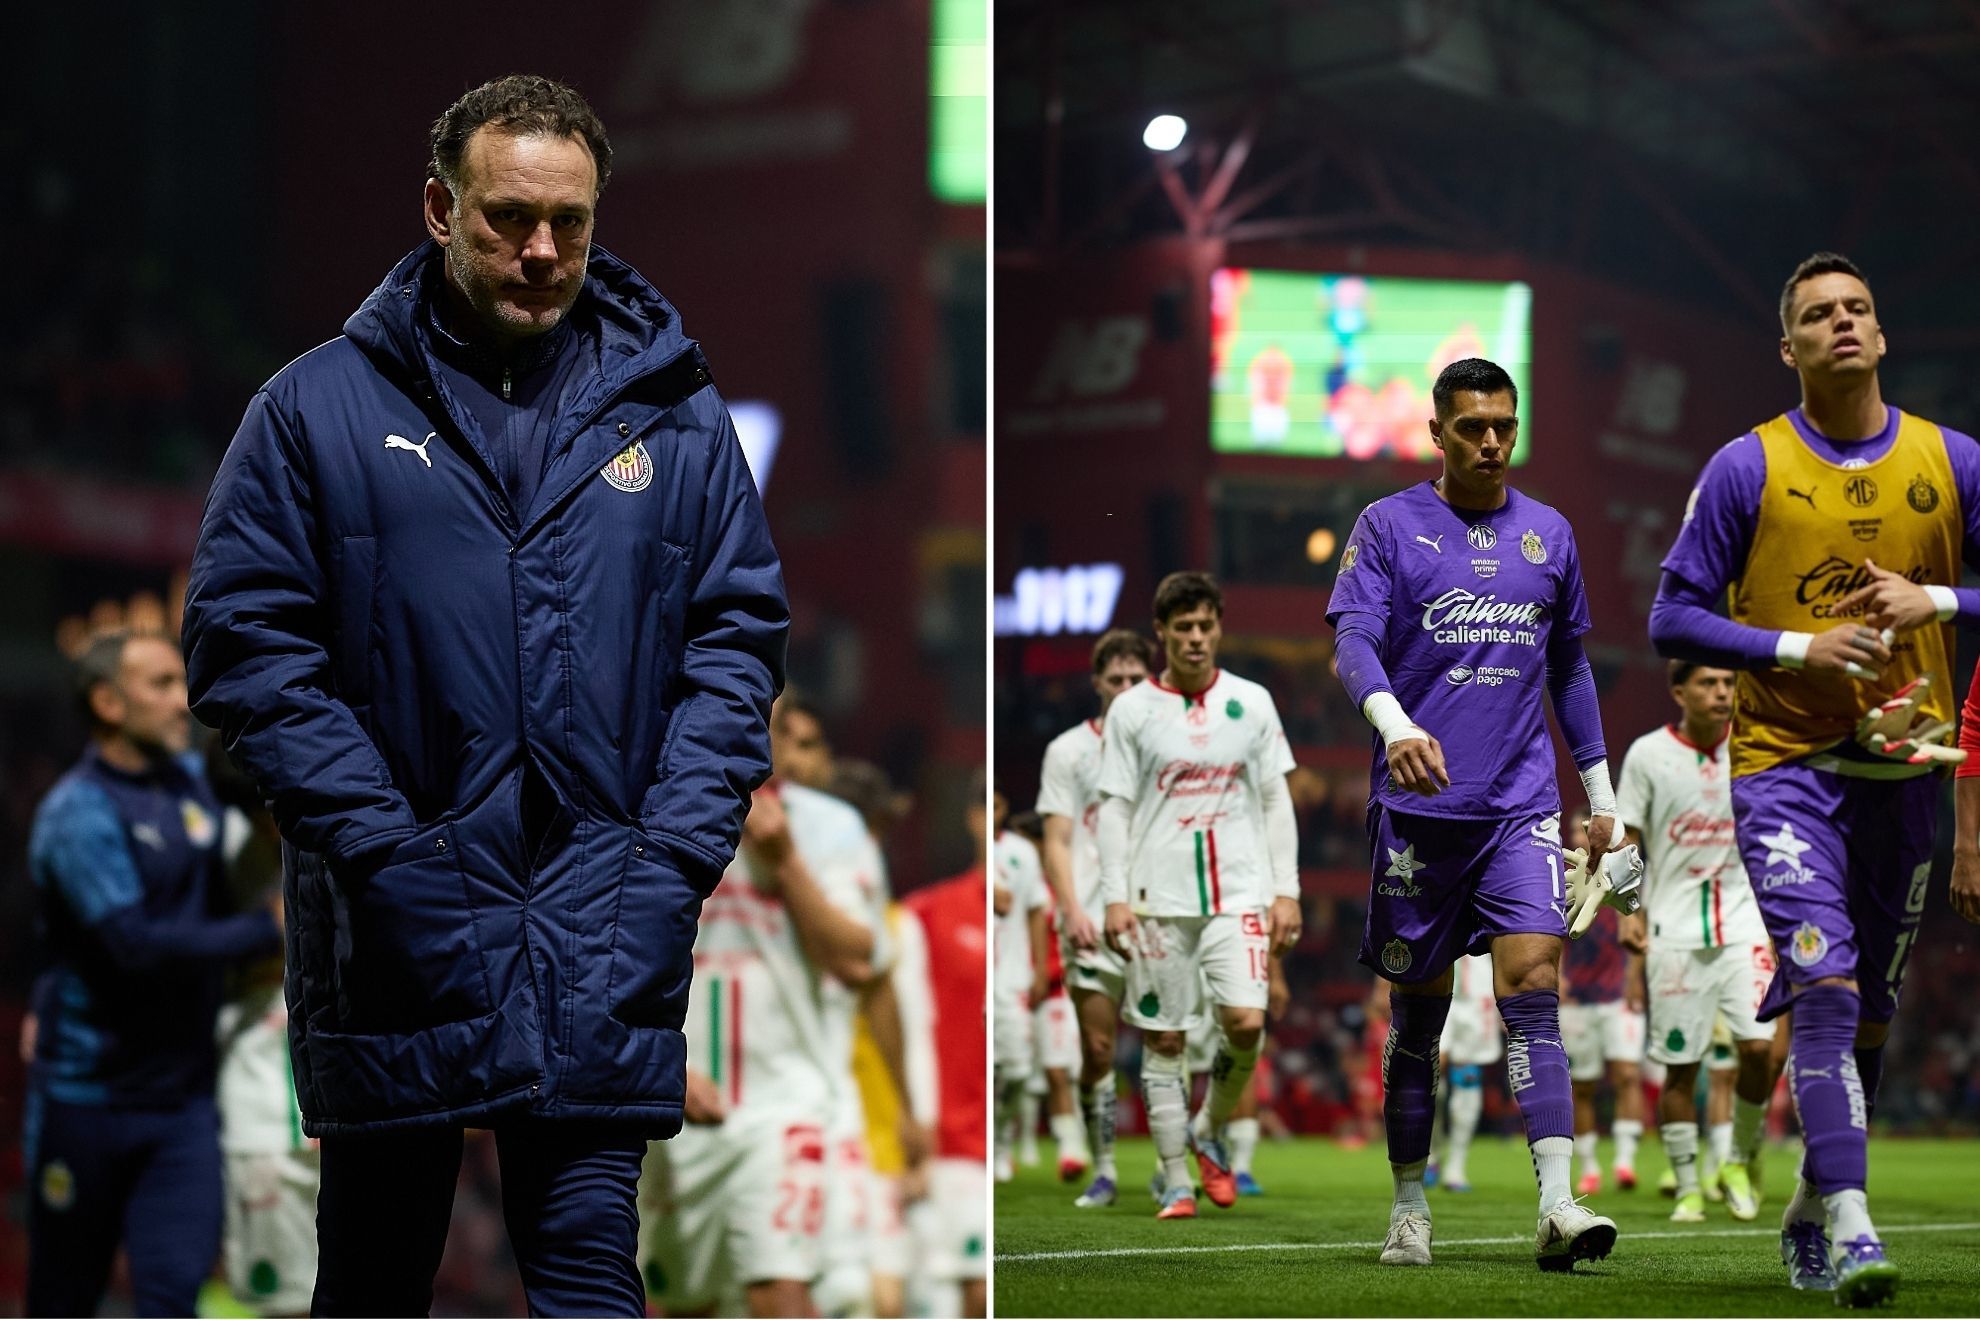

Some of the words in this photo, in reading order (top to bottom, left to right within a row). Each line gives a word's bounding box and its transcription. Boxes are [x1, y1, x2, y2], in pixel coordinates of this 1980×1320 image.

[1847, 479, 1876, 505] MG
[1469, 526, 1495, 549] MG
[1474, 565, 1498, 574] prime
[1421, 587, 1543, 631] Caliente
[1433, 625, 1536, 646] caliente.mx
[1476, 675, 1504, 687] pago
[1477, 666, 1520, 677] mercado
[1546, 853, 1561, 899] 1
[1377, 882, 1406, 897] Carl's
